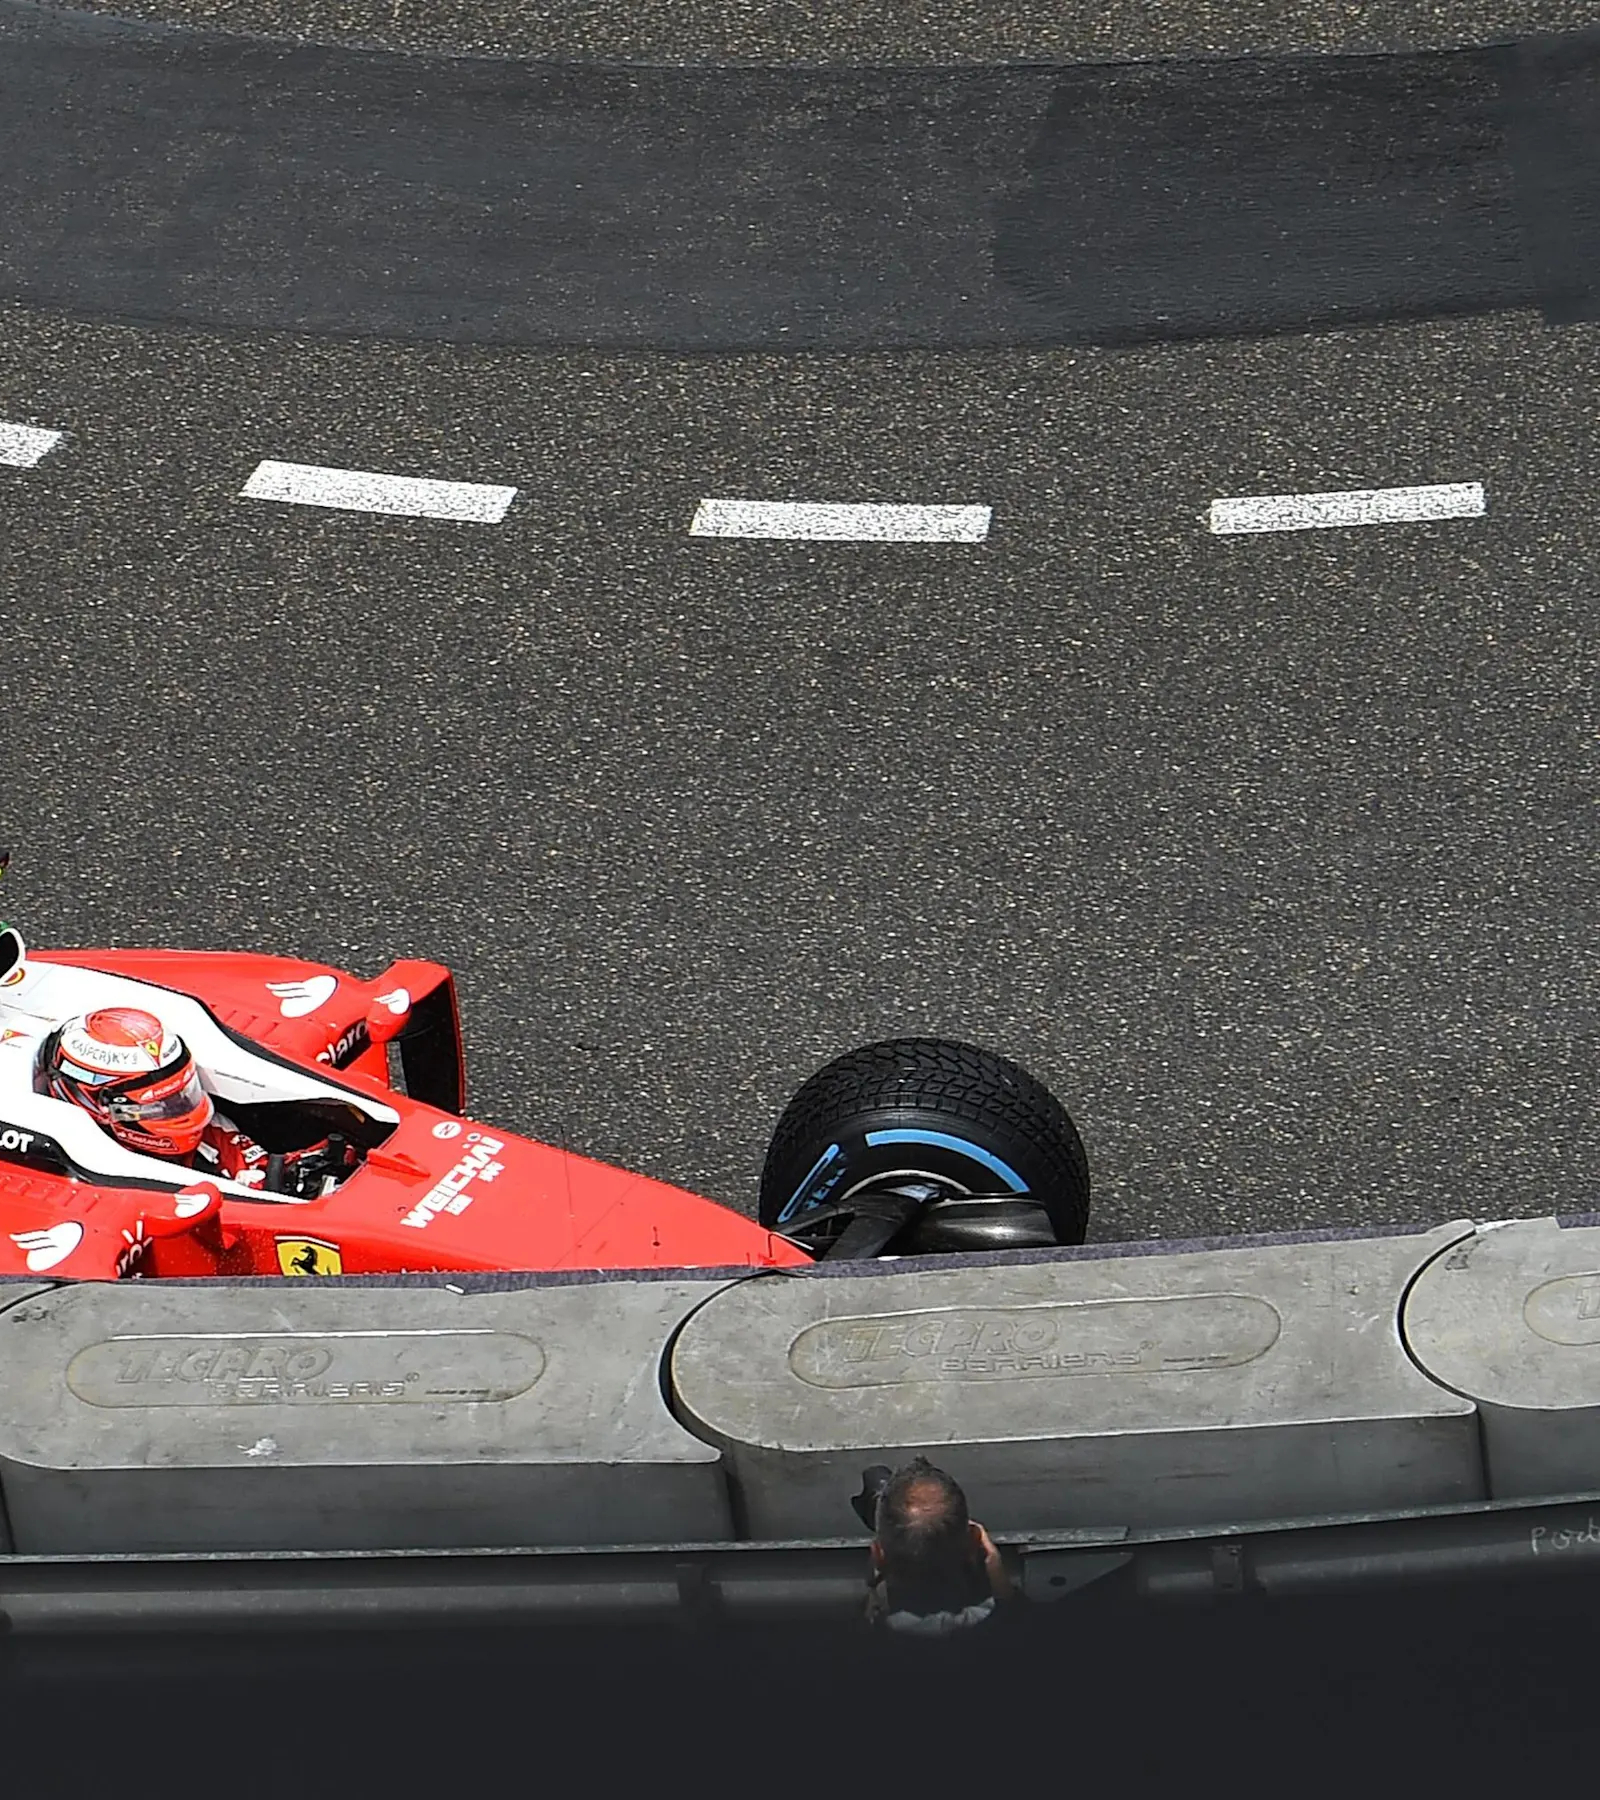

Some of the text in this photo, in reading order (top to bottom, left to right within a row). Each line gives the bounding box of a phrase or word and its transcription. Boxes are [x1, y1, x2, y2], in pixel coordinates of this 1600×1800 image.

[400, 1135, 505, 1229] WEICHAI
[842, 1317, 1061, 1363] TECPRO
[115, 1346, 332, 1383] TECPRO
